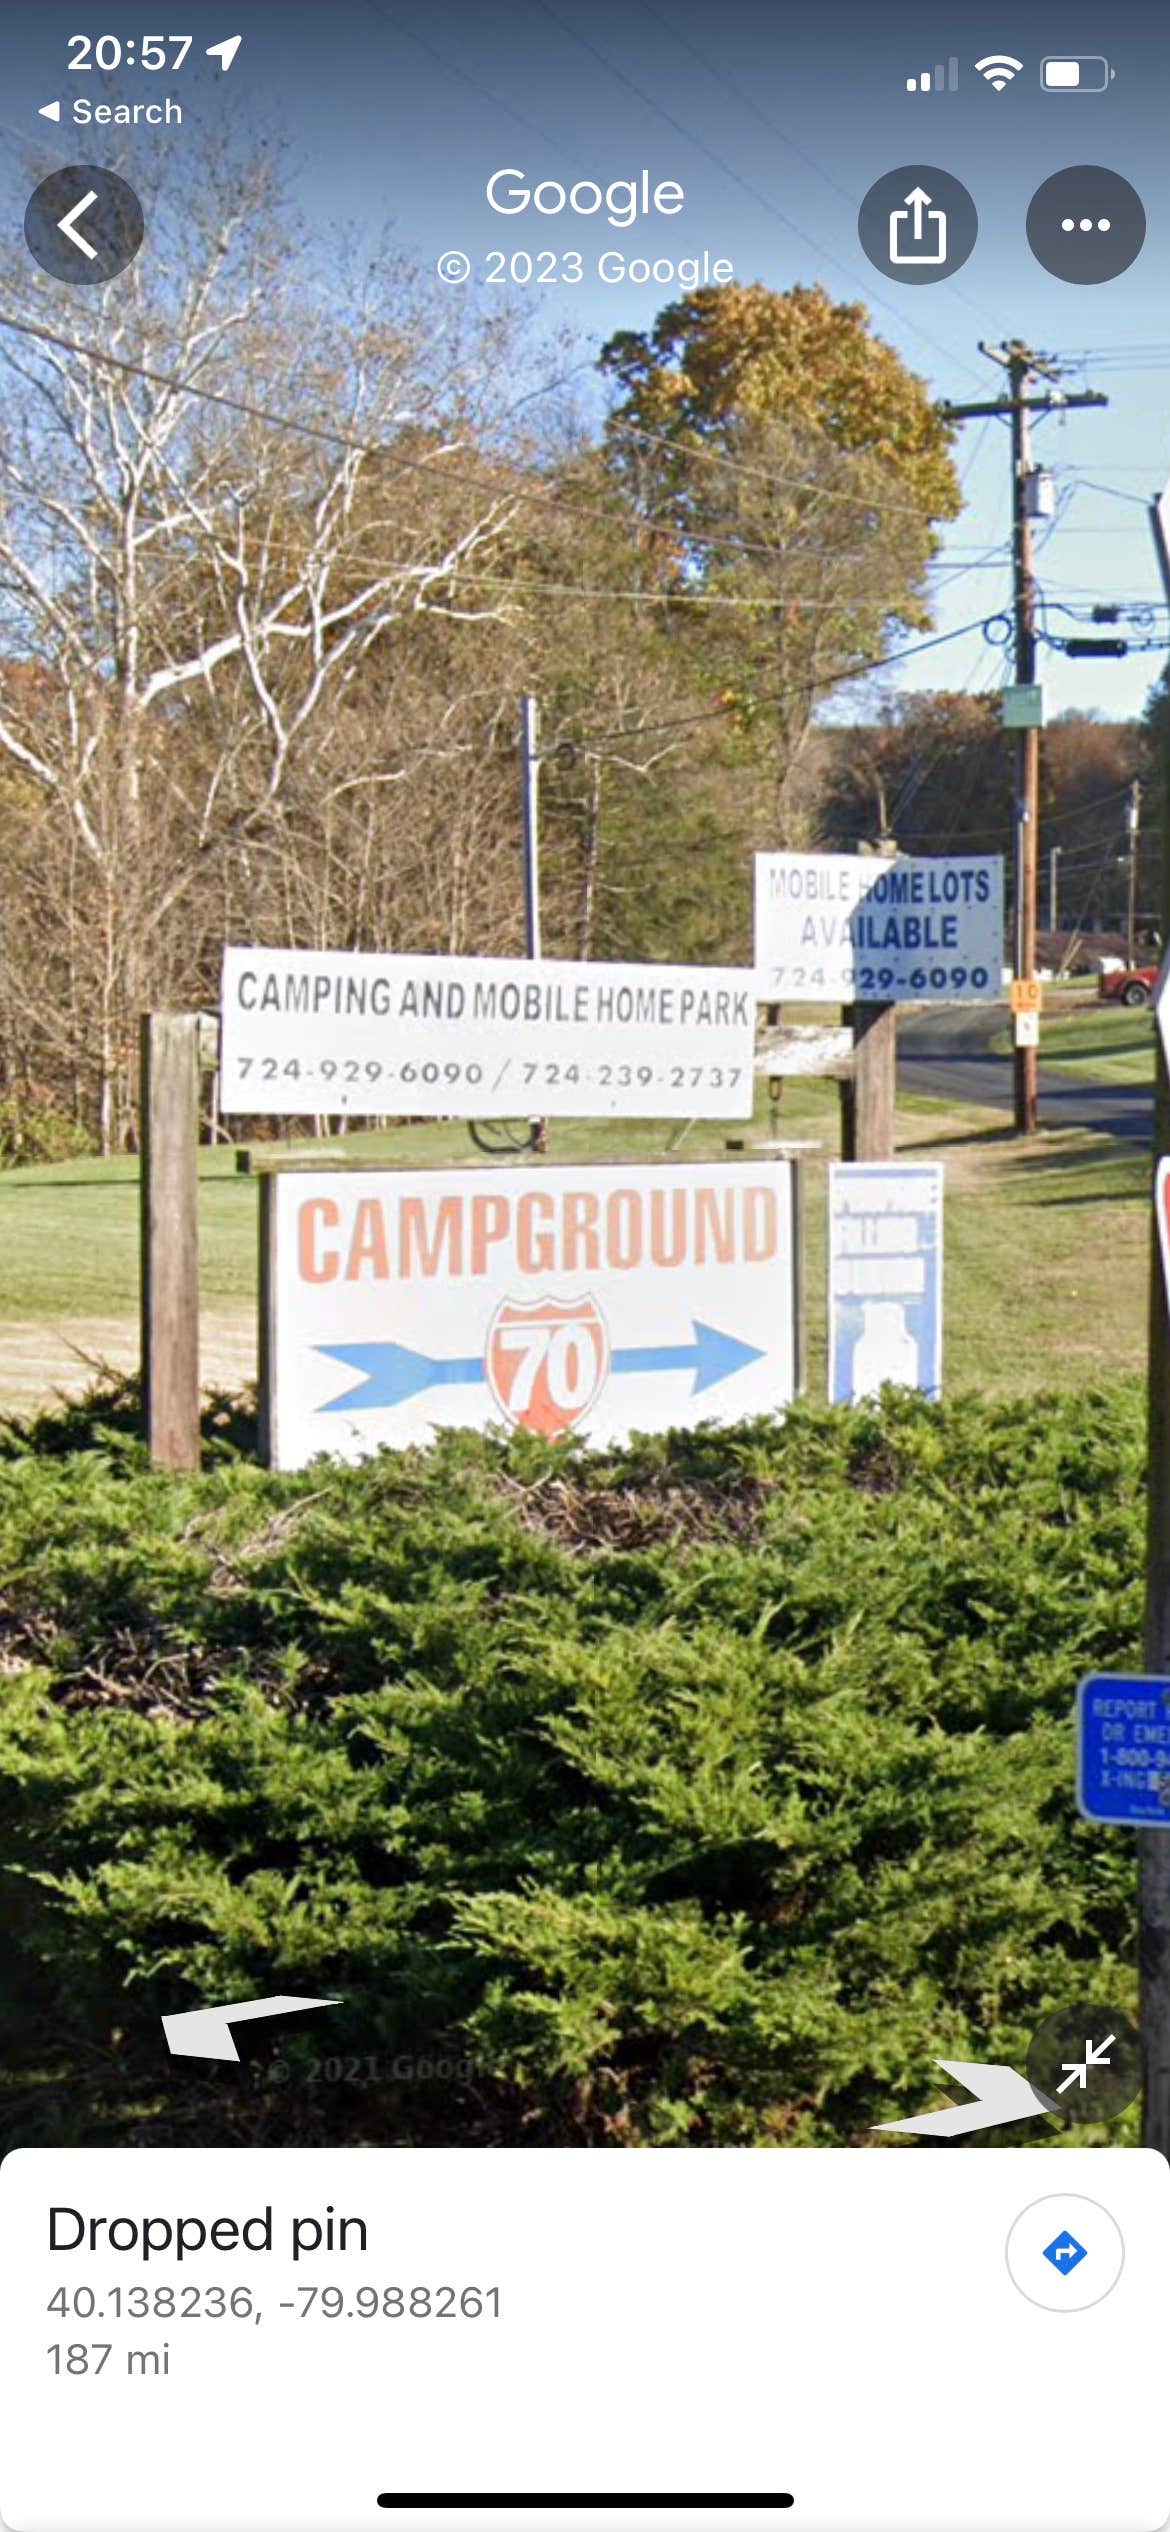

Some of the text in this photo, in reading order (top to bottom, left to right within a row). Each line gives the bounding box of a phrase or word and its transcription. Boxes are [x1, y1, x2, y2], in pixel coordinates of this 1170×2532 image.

[768, 868, 990, 902] MOBILE HOME LOTS
[802, 913, 959, 949] AVAILABLE
[772, 966, 990, 990] 724-929-6090
[237, 970, 749, 1026] CAMPING AND MOBILE HOME PARK
[236, 1056, 484, 1085] 724-929-6090
[522, 1062, 743, 1090] 724-239-2737
[297, 1186, 778, 1284] CAMPGROUND
[500, 1326, 596, 1410] 70
[1093, 1698, 1156, 1719] REPORT
[1102, 1721, 1126, 1742] OR
